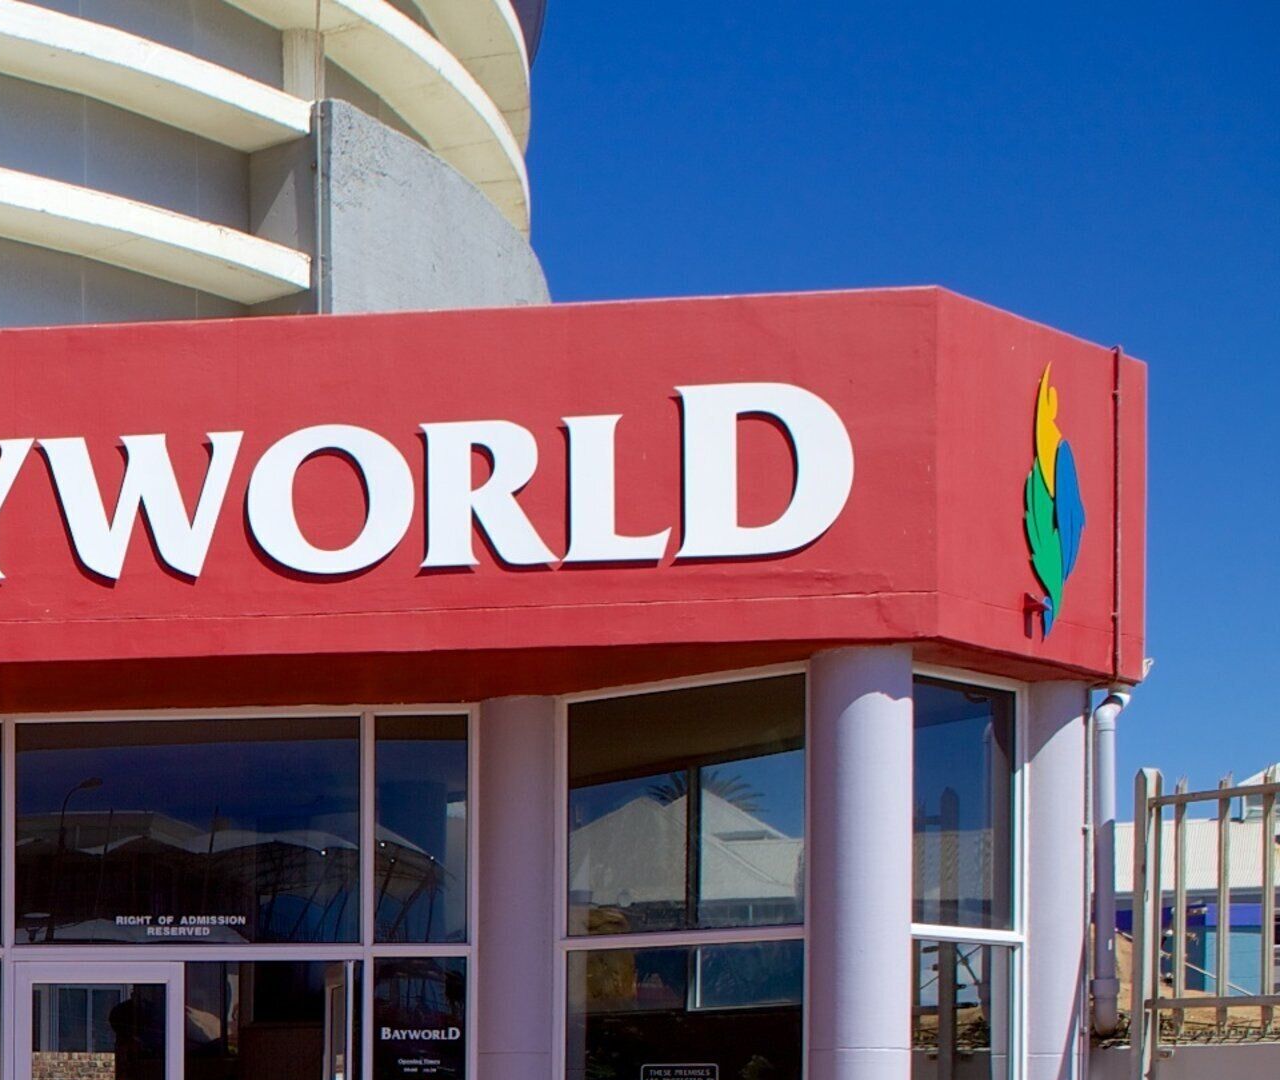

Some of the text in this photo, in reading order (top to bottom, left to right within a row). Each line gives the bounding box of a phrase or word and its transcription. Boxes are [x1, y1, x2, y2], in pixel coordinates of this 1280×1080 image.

[115, 915, 246, 925] RIGHT OF ADMISSION
[147, 926, 210, 936] RESERVED
[381, 1026, 461, 1040] BAYWORLD
[649, 1069, 711, 1077] THESE PREMISES
